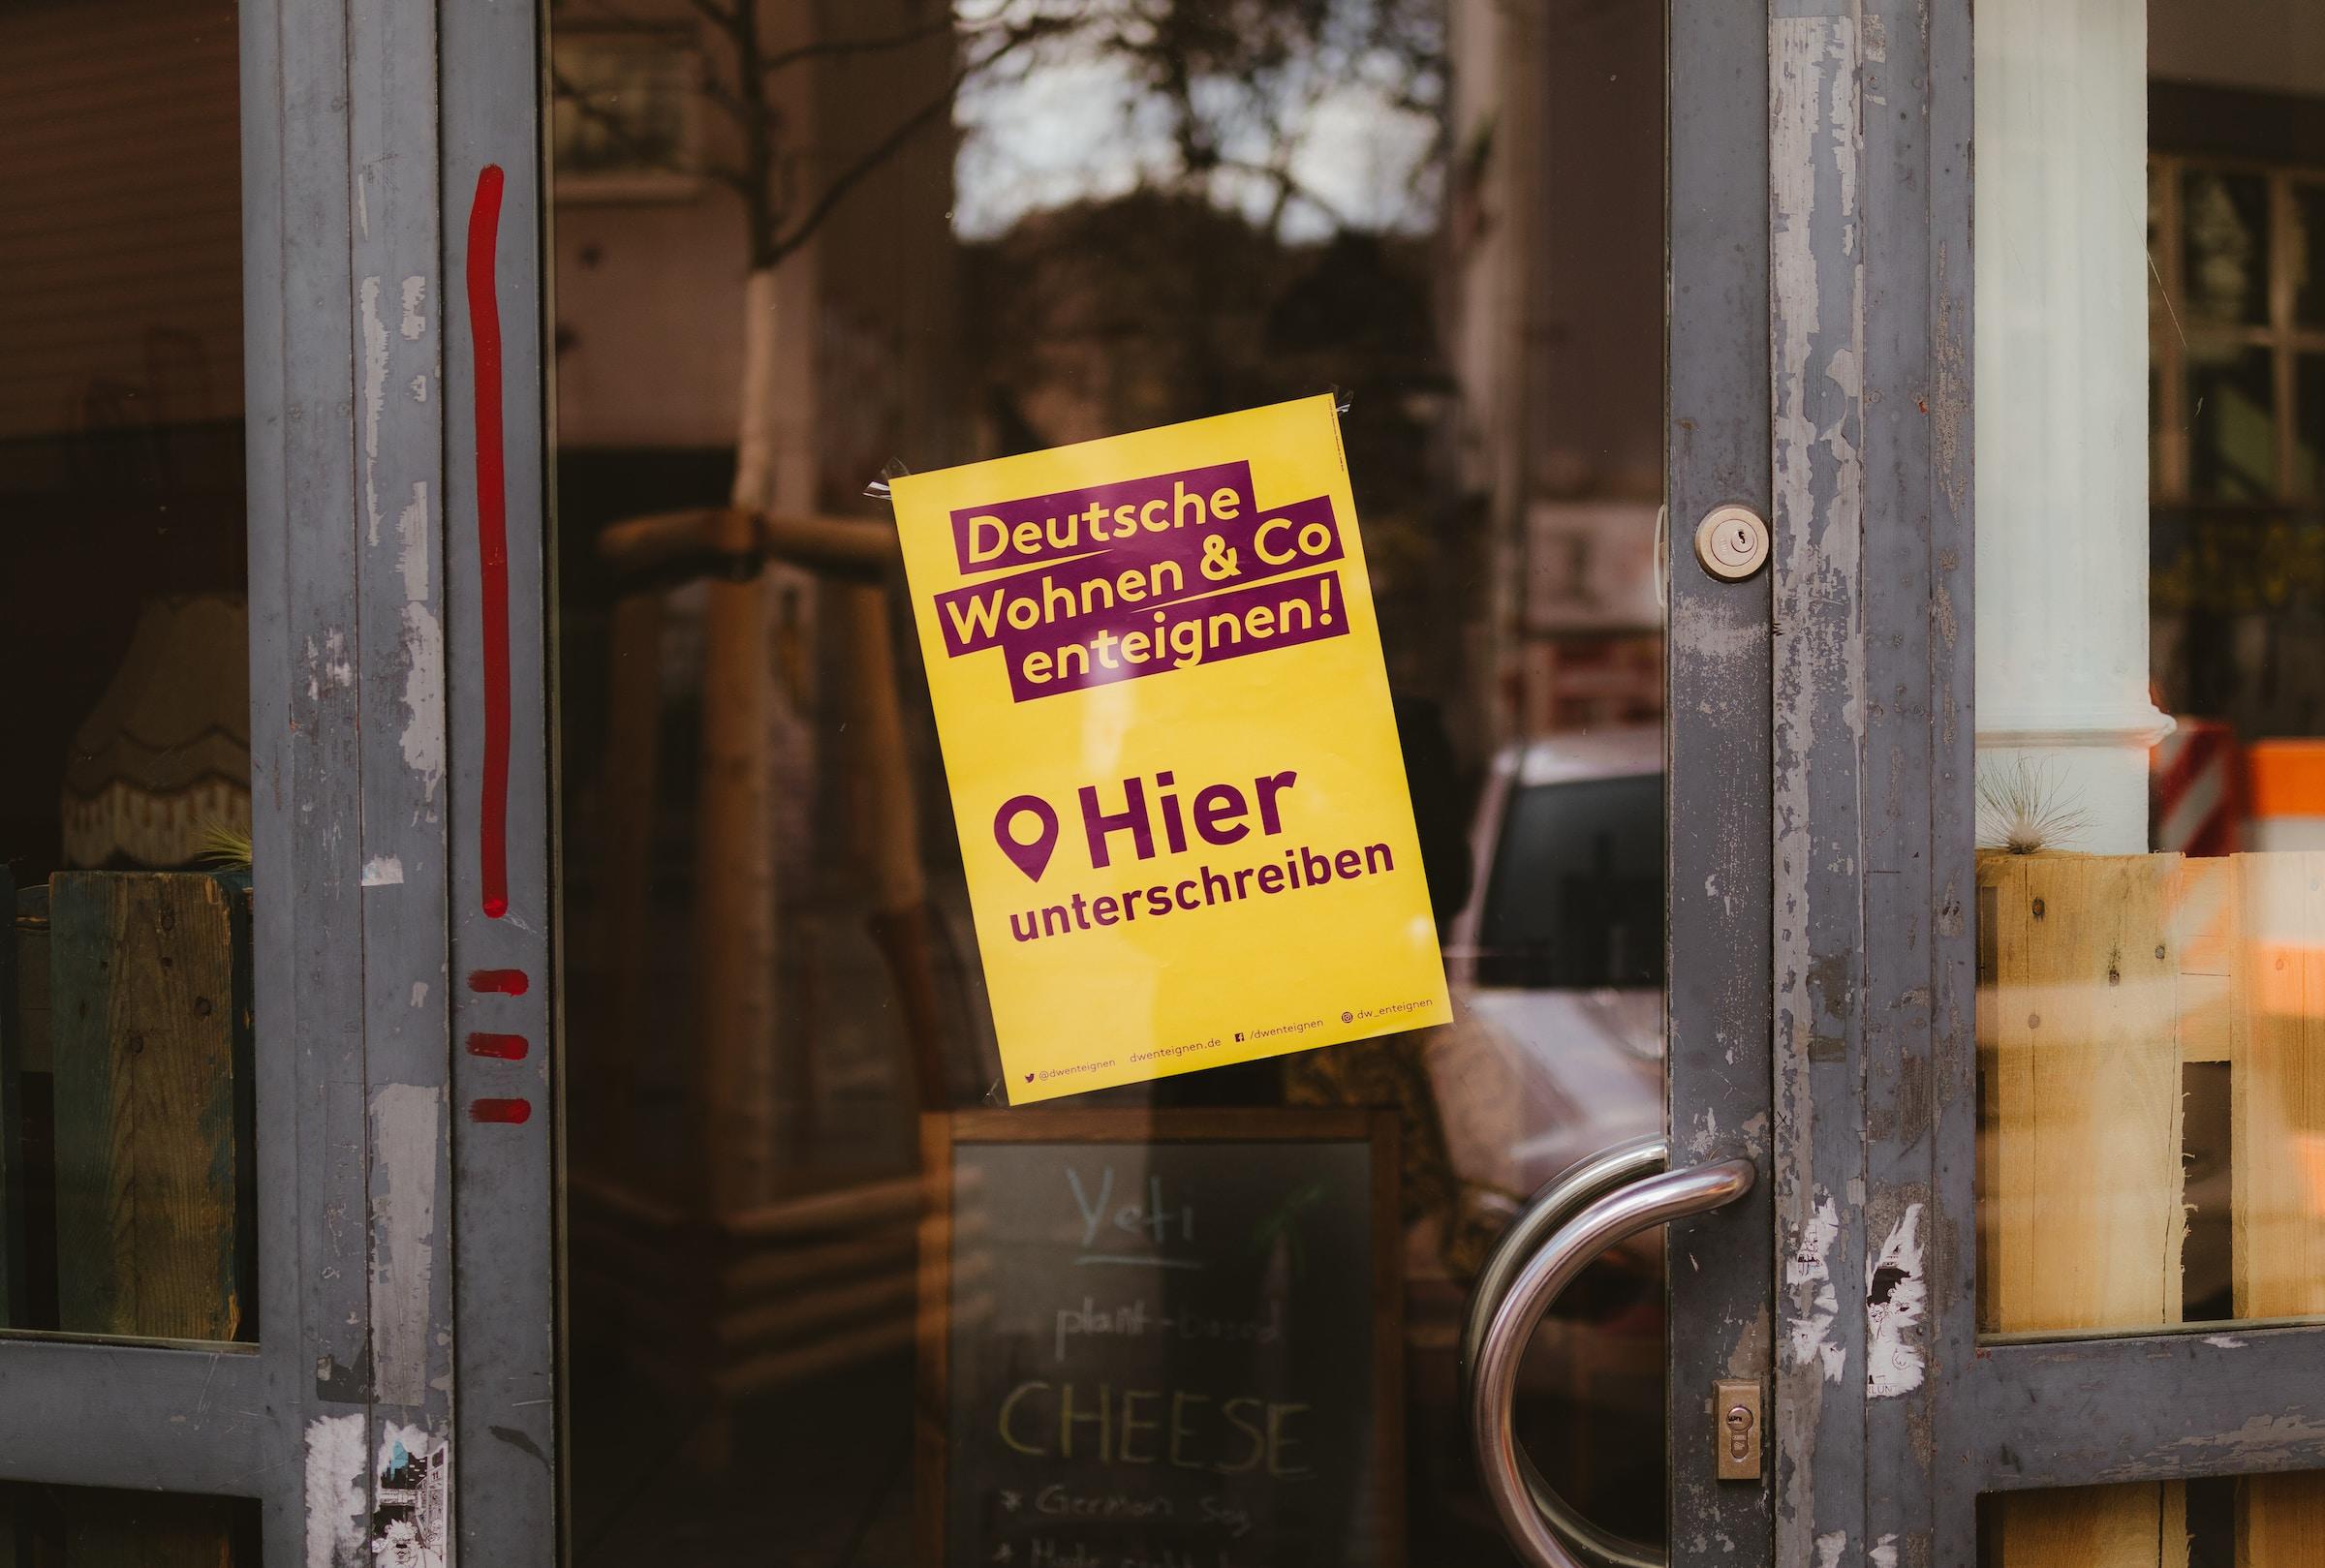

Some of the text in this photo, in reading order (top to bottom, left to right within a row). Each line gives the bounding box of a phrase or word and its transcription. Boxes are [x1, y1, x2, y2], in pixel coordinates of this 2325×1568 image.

[968, 481, 1241, 565] Deutsche
[946, 518, 1332, 645] Wohnen & Co
[1022, 579, 1333, 684] enteignen!
[1079, 771, 1297, 870] Hier
[1009, 842, 1394, 942] unterschreiben
[1038, 999, 1433, 1081] @dwenteignen dwenteignen.de /dwenteignen dw_enteignen
[1065, 1165, 1194, 1247] Yeti
[998, 1380, 1315, 1479] CHEESE
